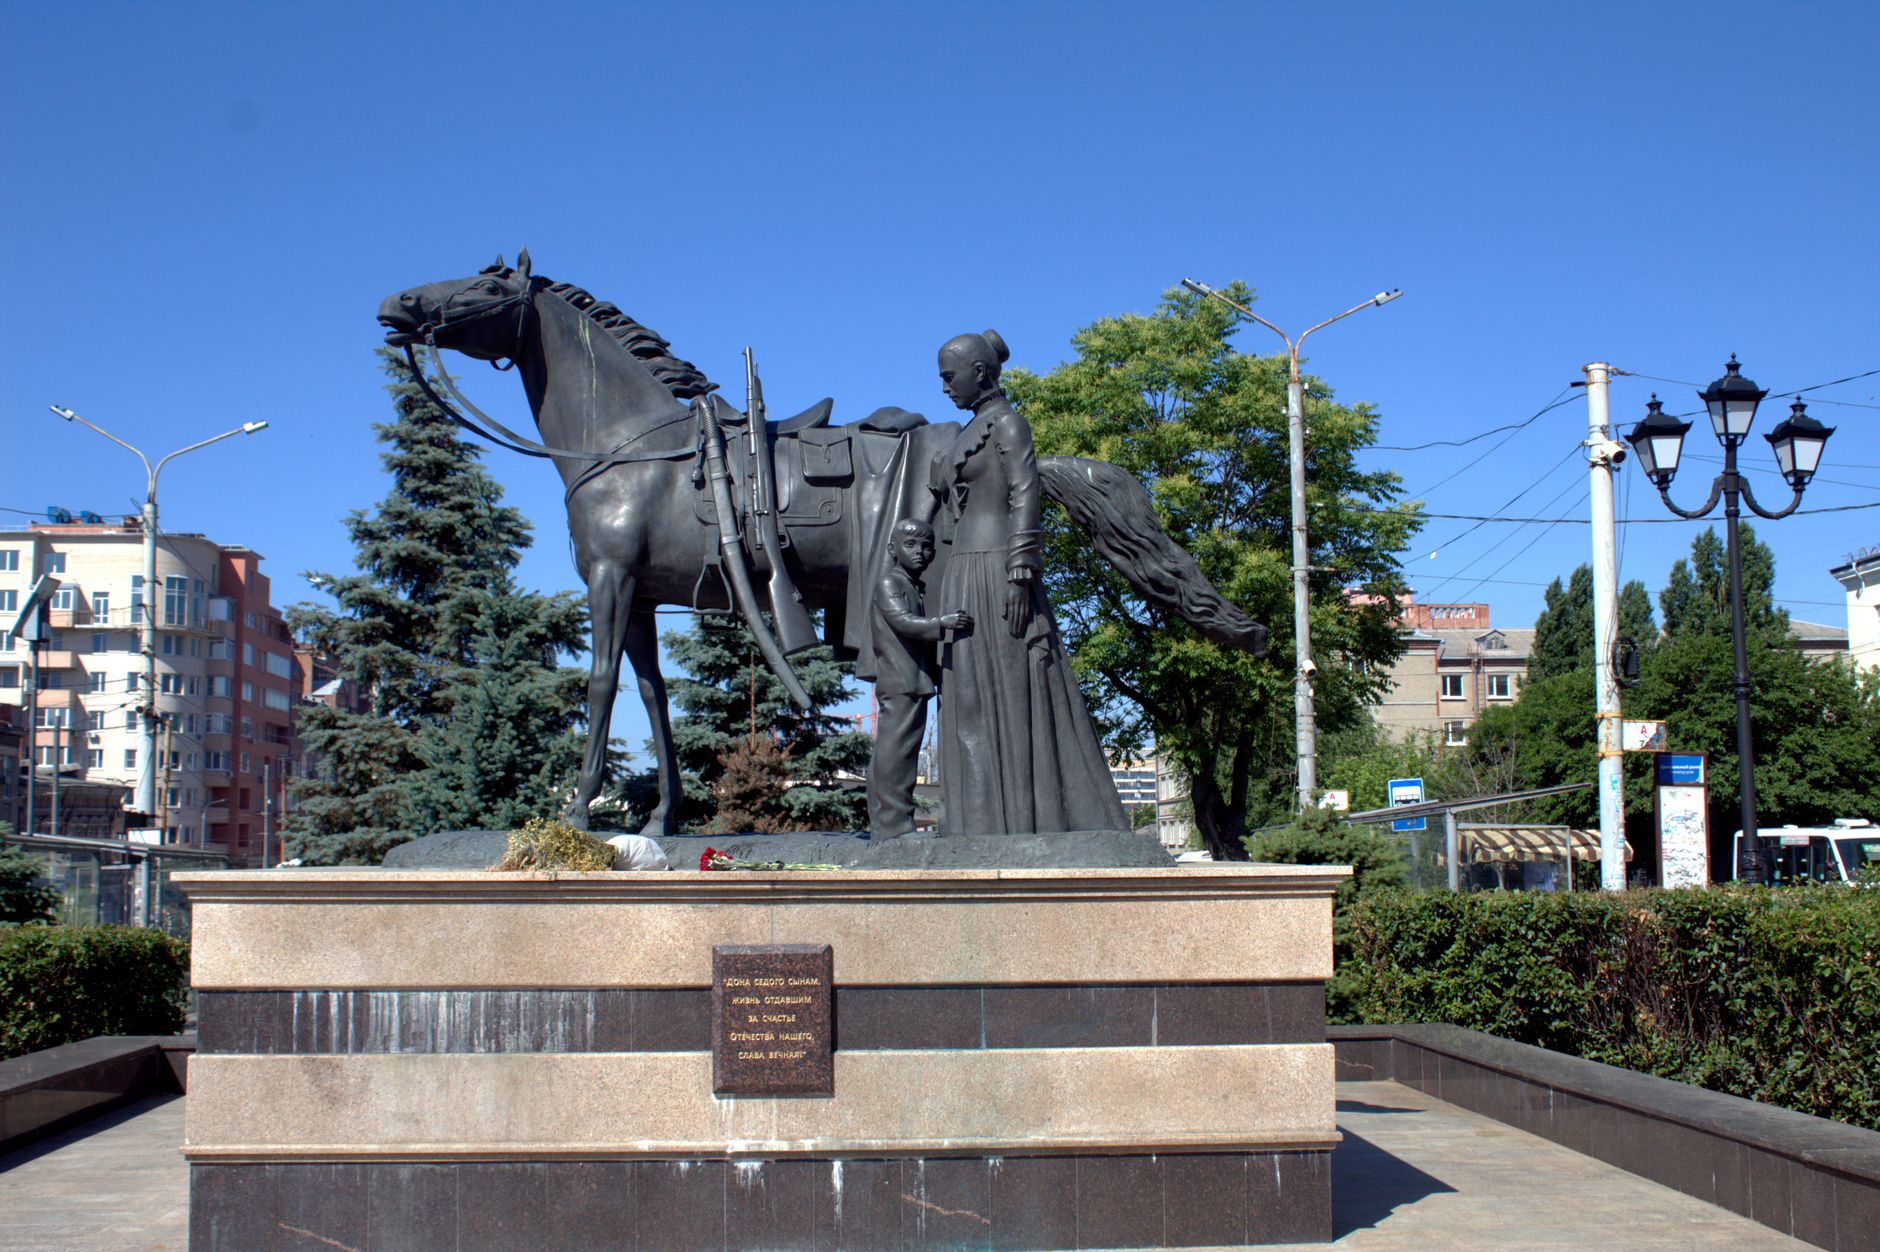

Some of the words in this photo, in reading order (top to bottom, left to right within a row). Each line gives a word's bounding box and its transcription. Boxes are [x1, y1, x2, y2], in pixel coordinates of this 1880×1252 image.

[754, 978, 785, 987] СЕДОГО
[732, 997, 760, 1005] ЖИЗНЬ
[764, 996, 812, 1005] ОТДАВШИМ
[748, 1015, 758, 1023] ЗА
[762, 1014, 796, 1023] СЧАСТЬЕ
